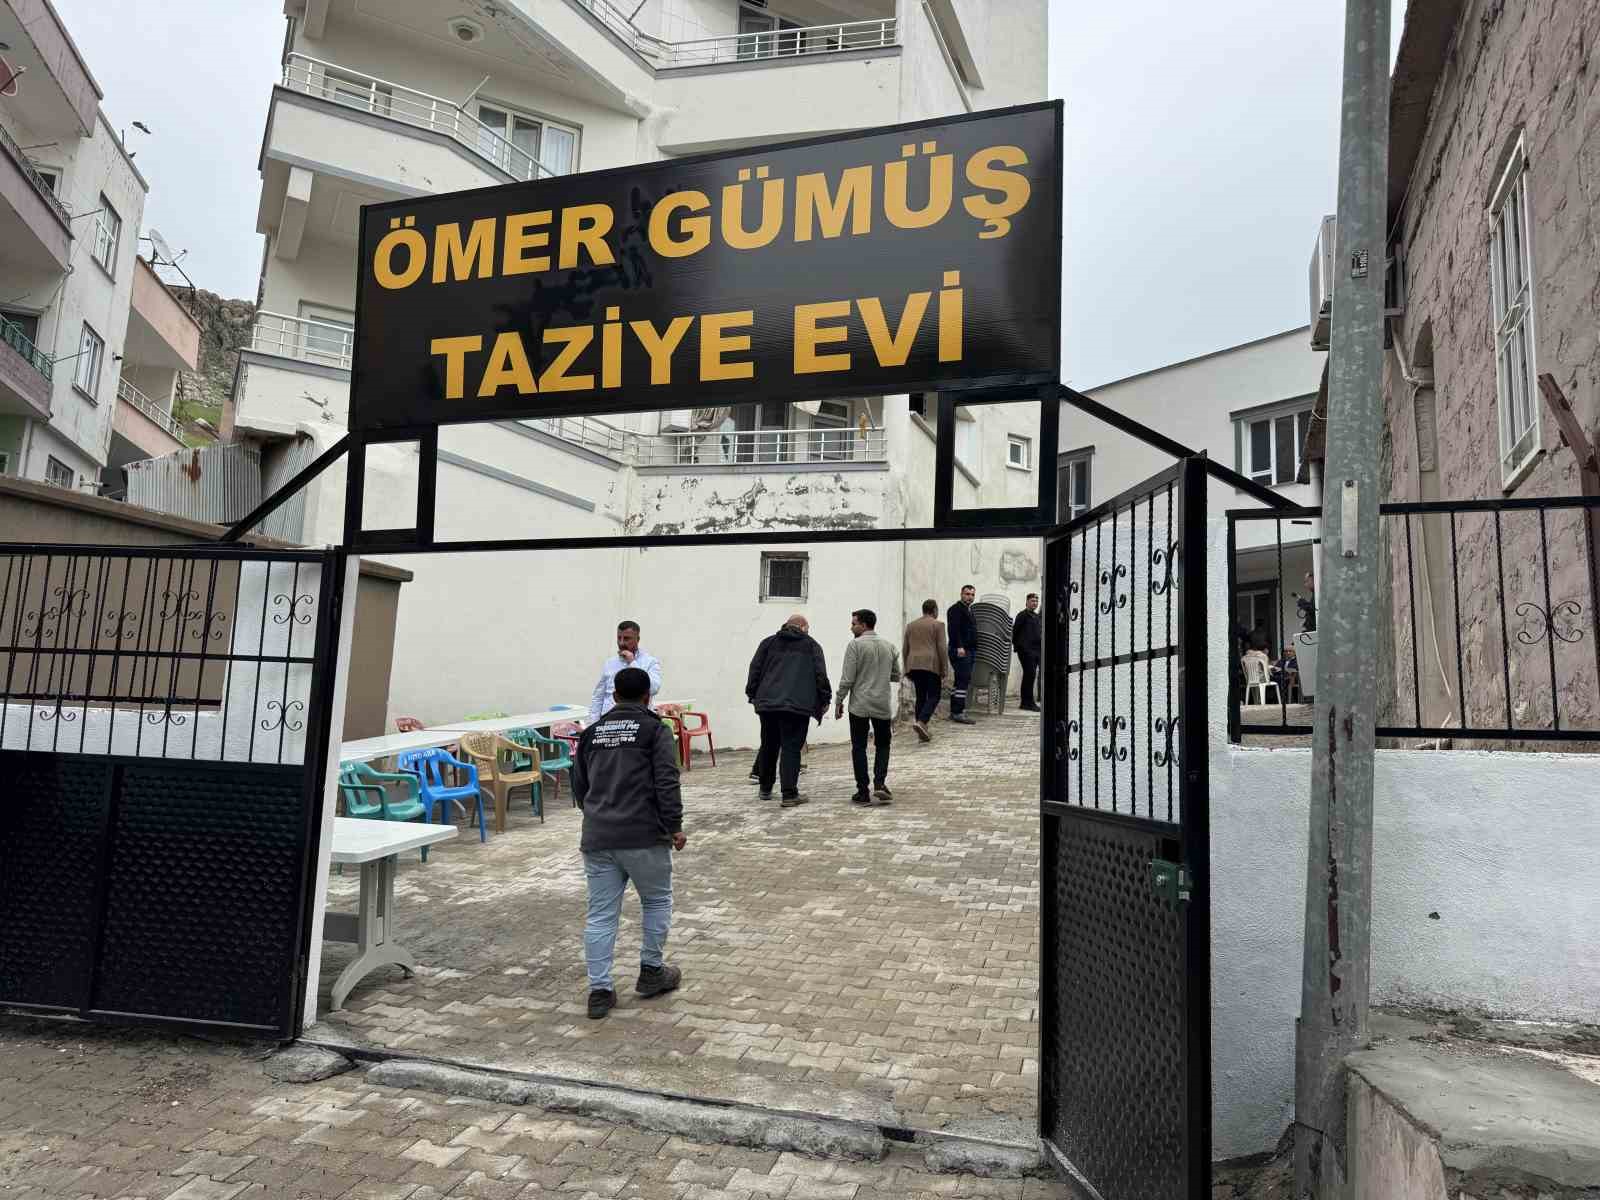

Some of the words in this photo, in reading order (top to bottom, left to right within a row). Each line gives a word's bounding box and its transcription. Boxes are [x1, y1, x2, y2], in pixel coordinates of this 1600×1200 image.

[373, 203, 615, 290] ÖMER
[648, 140, 1031, 258] GÜMÜŞ
[430, 306, 753, 399] TAZİYE
[794, 270, 964, 375] EVİ
